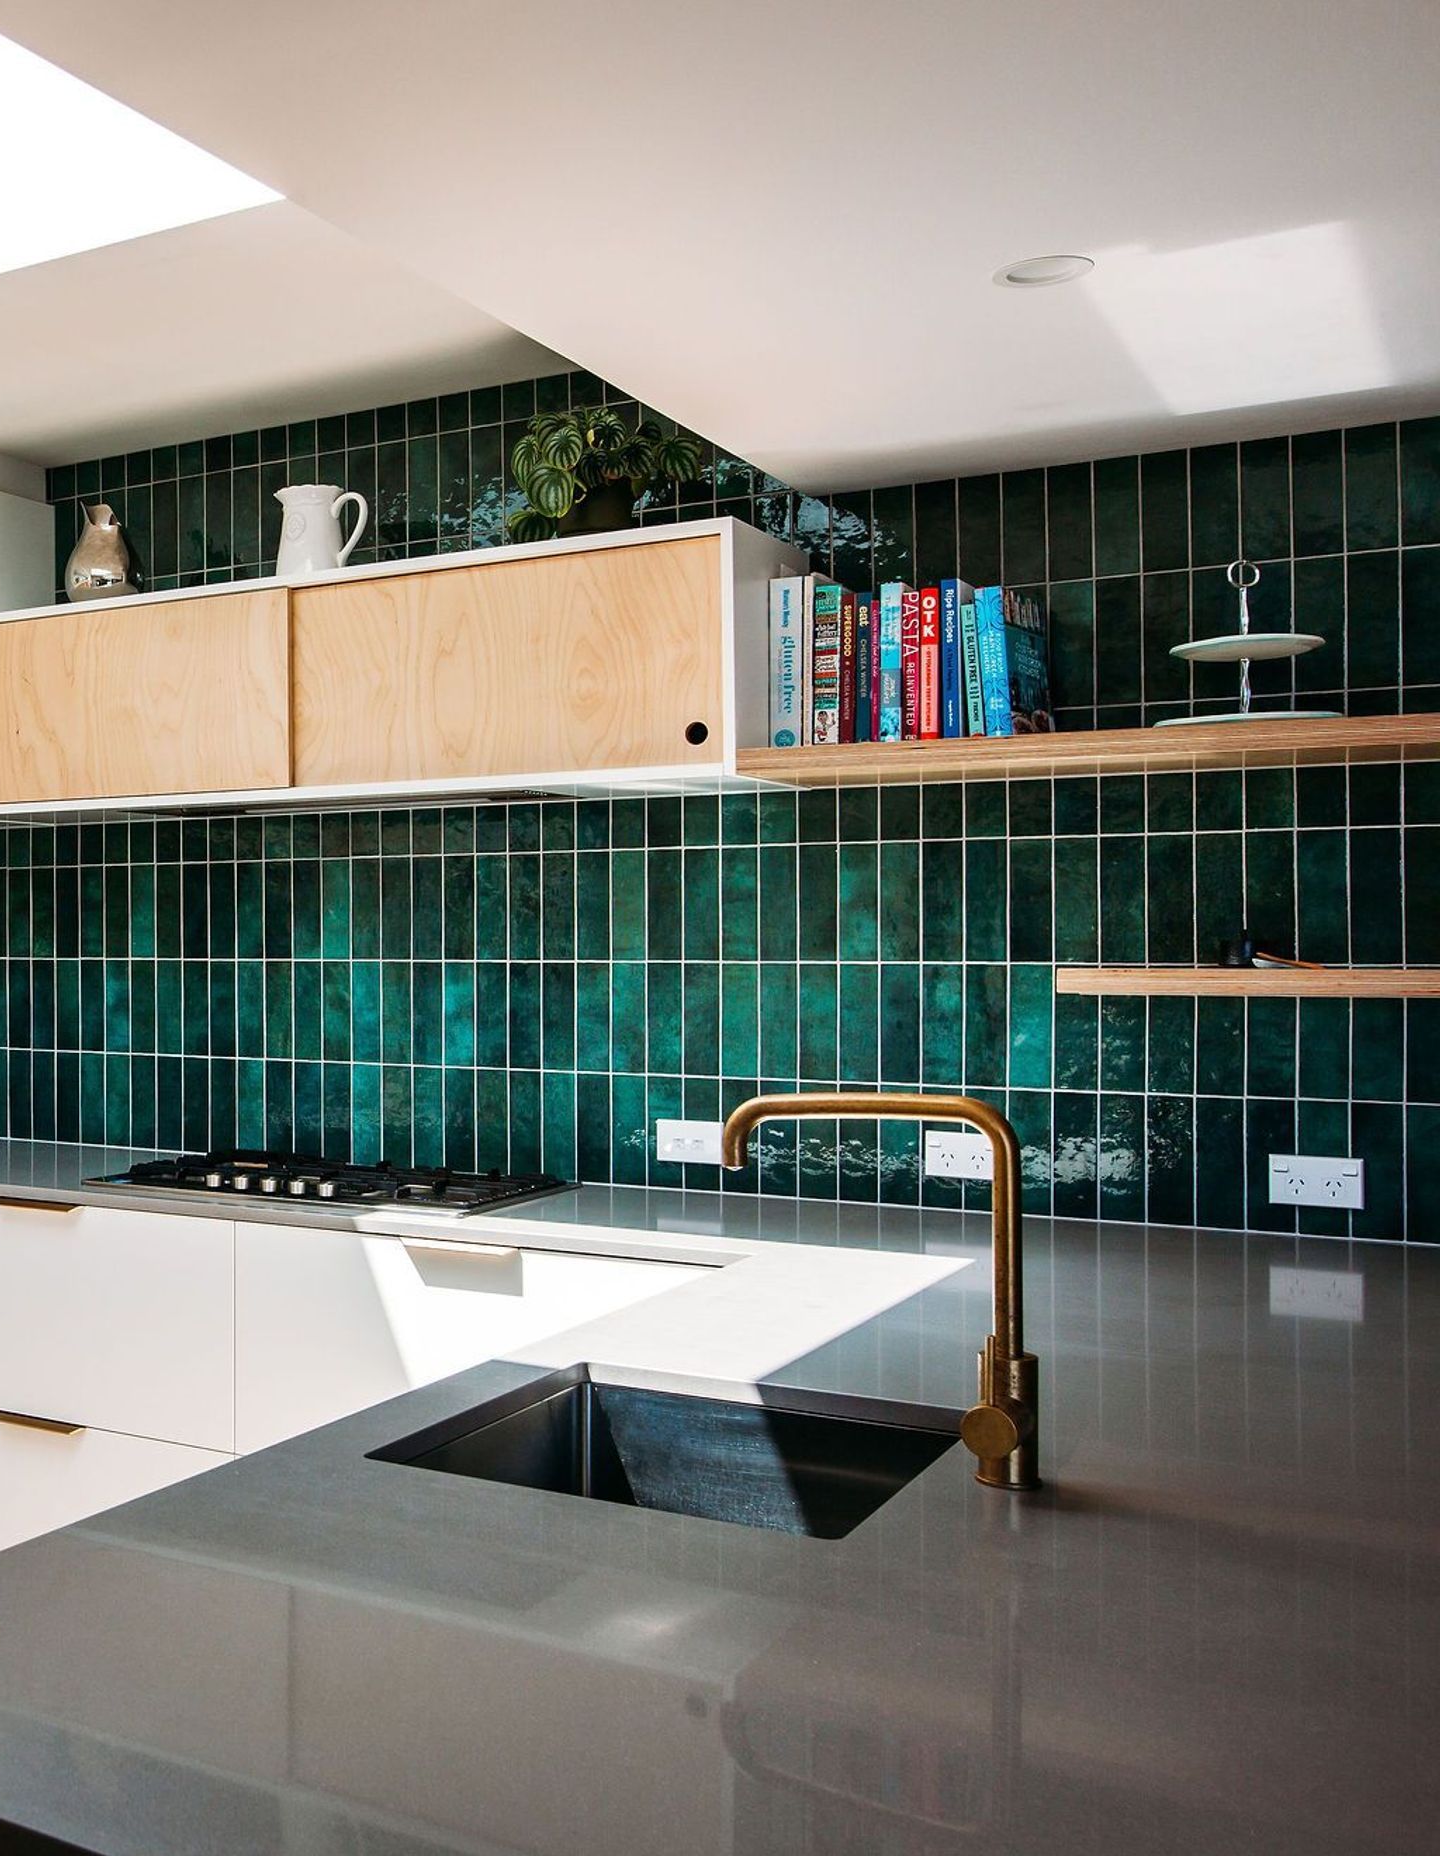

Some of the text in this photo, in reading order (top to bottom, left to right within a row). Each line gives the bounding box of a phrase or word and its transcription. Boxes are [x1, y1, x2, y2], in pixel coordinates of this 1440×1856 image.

[859, 605, 869, 627] eat
[944, 588, 954, 608] Ripe
[902, 591, 920, 657] PASTA
[945, 609, 955, 643] Recipes
[781, 636, 796, 681] gluten
[966, 635, 977, 683] GLUTEN FREE
[783, 685, 796, 714] free
[906, 661, 915, 726] REINVENTED
